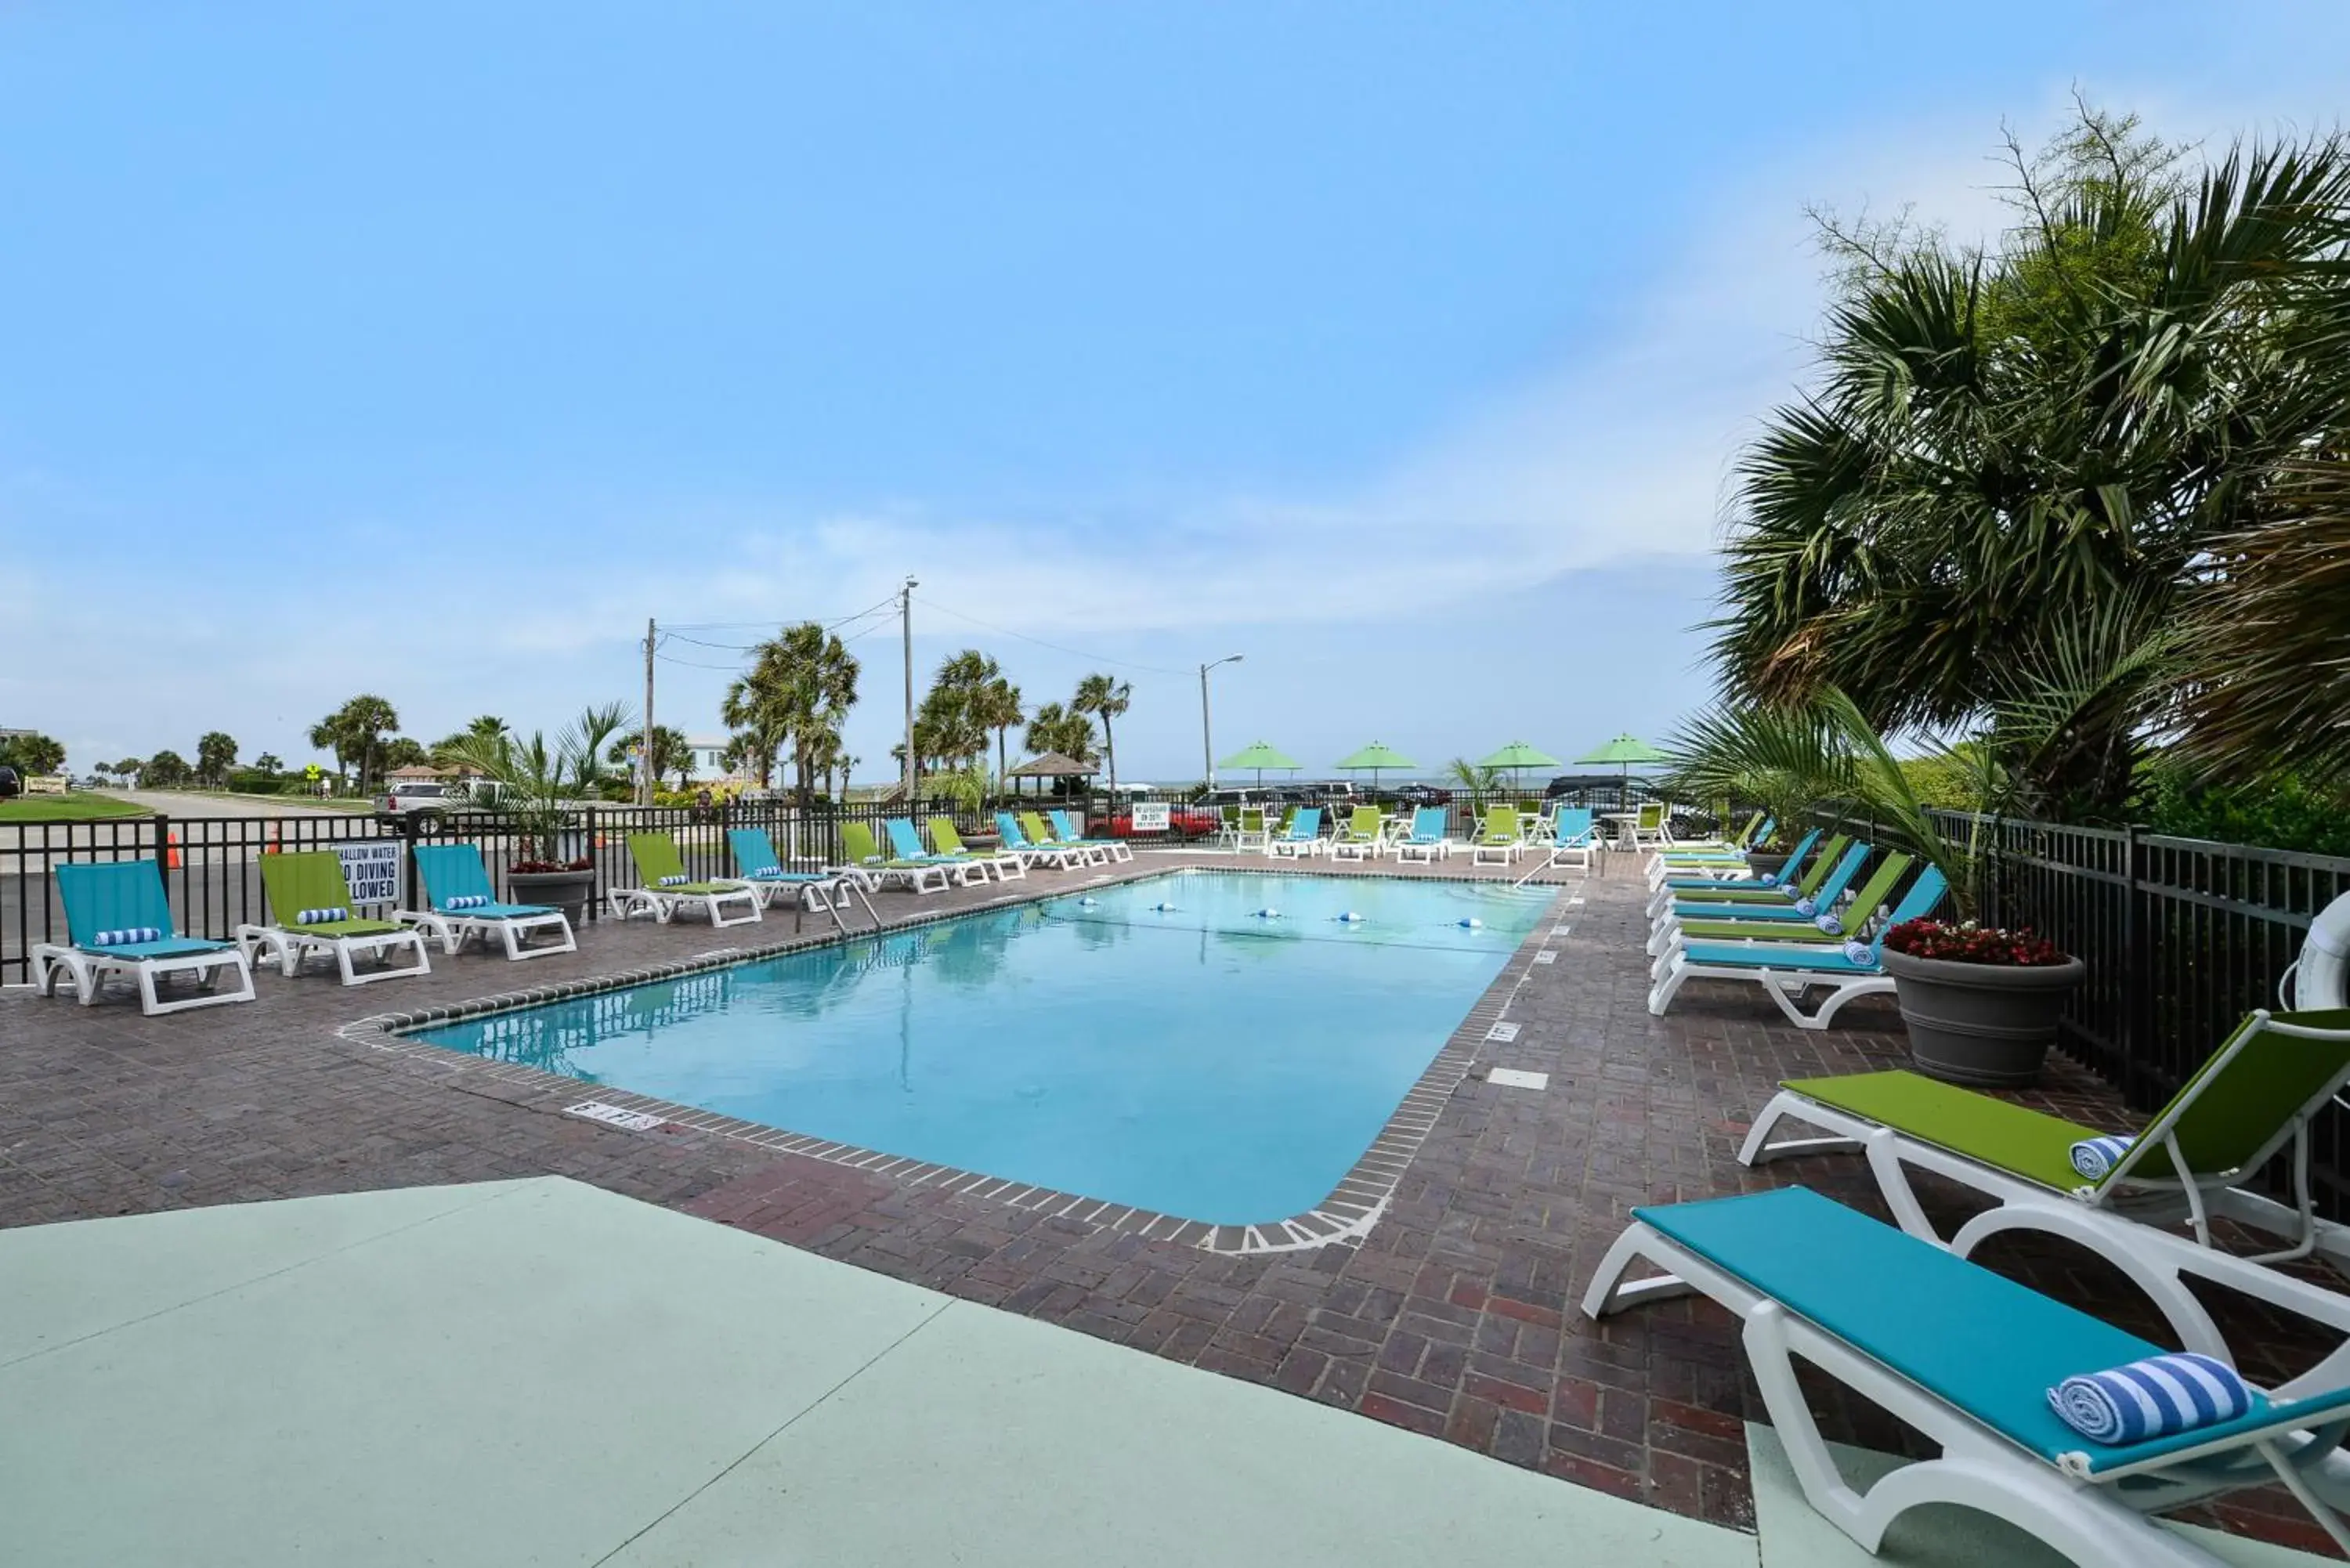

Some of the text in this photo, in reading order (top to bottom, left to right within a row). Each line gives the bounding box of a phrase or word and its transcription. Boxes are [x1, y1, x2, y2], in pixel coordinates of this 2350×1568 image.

[339, 847, 396, 860] HALLOW WATER
[356, 862, 395, 880] DIVING
[345, 880, 394, 899] LOWED
